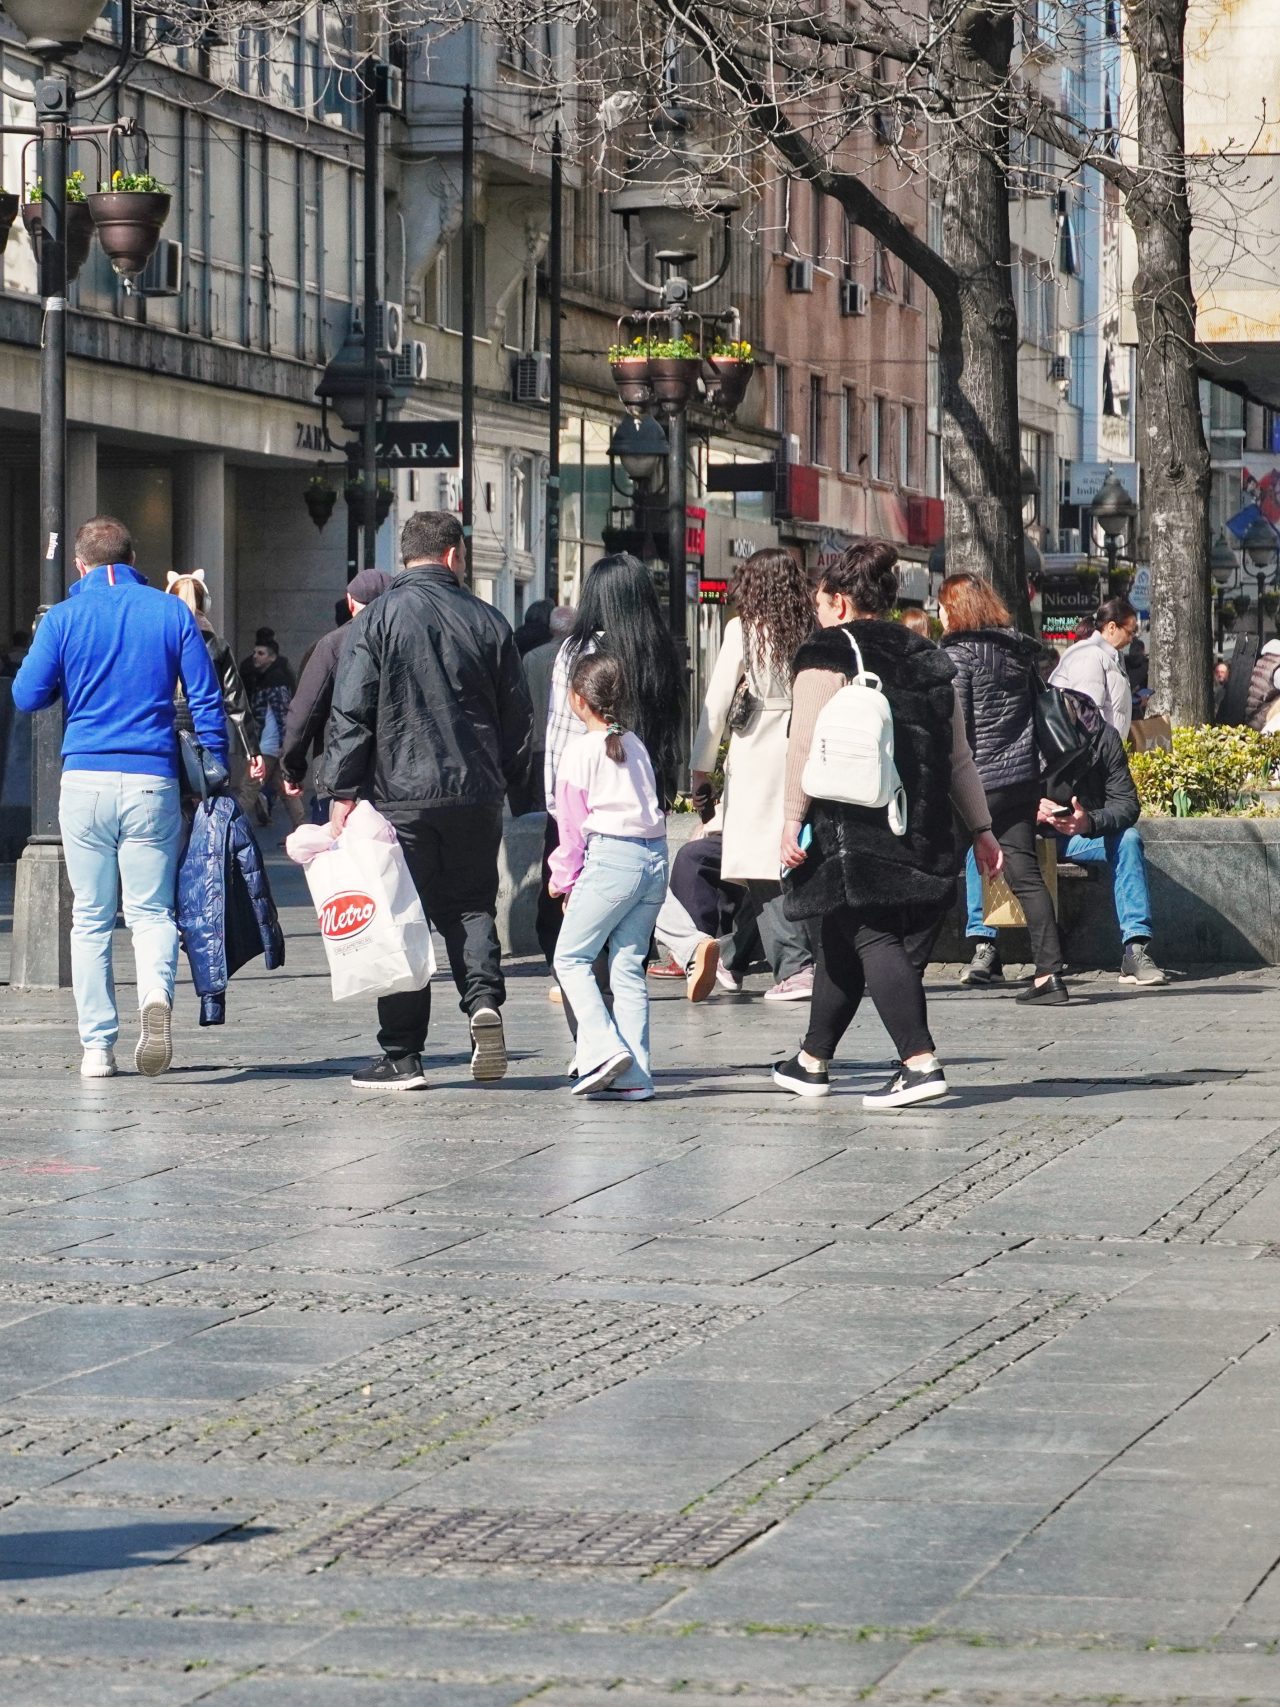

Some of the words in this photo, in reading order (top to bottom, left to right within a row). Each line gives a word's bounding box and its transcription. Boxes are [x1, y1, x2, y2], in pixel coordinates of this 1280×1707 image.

[375, 442, 453, 459] ZARA
[1044, 591, 1088, 606] Nicola
[320, 903, 374, 934] Metro
